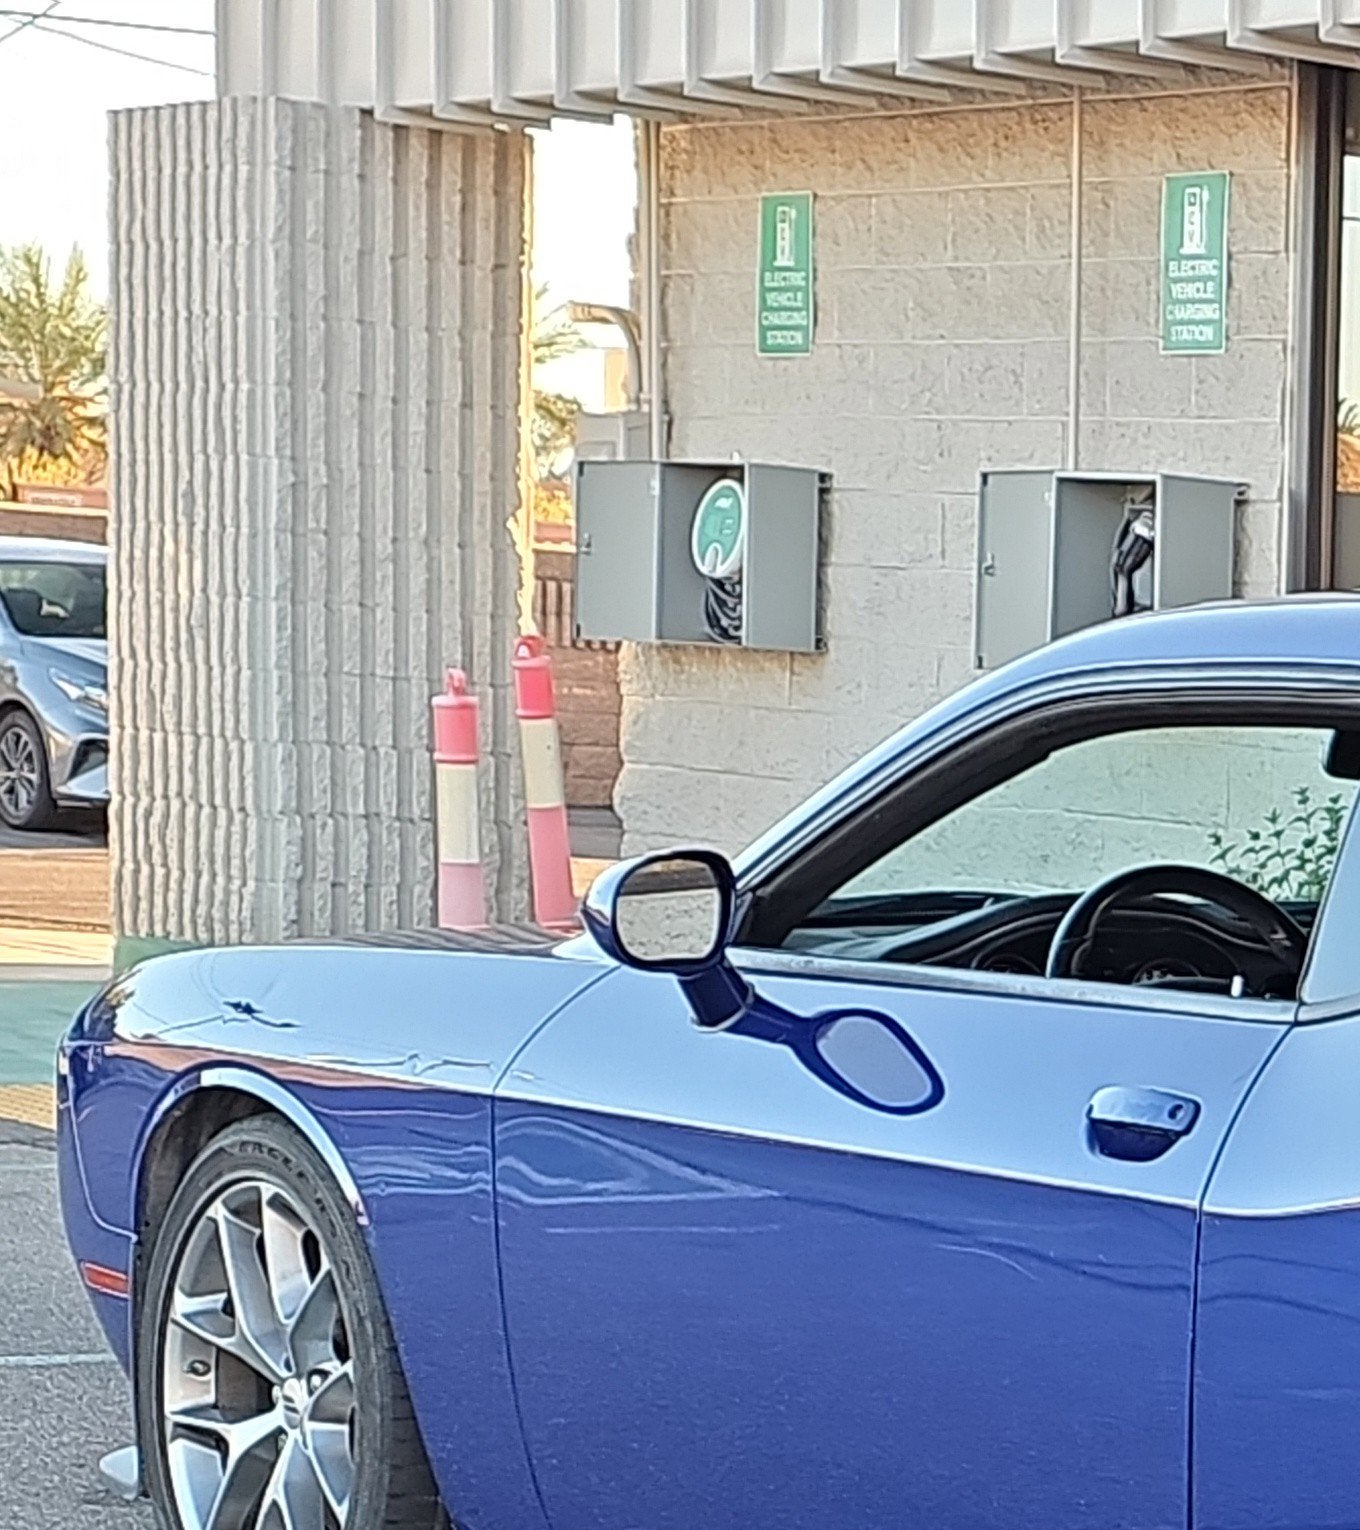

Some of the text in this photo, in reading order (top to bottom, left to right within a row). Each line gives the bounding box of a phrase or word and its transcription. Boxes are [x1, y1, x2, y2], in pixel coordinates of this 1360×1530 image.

[1168, 259, 1218, 277] ELECTRIC
[764, 271, 805, 287] ELECTRIC
[1170, 281, 1215, 299] VEHICLE
[765, 292, 803, 307] VEHICLE
[761, 311, 807, 325] CHARGING
[1166, 303, 1219, 320] CHARGING
[766, 331, 802, 345] STATION
[1170, 325, 1214, 341] STATION
